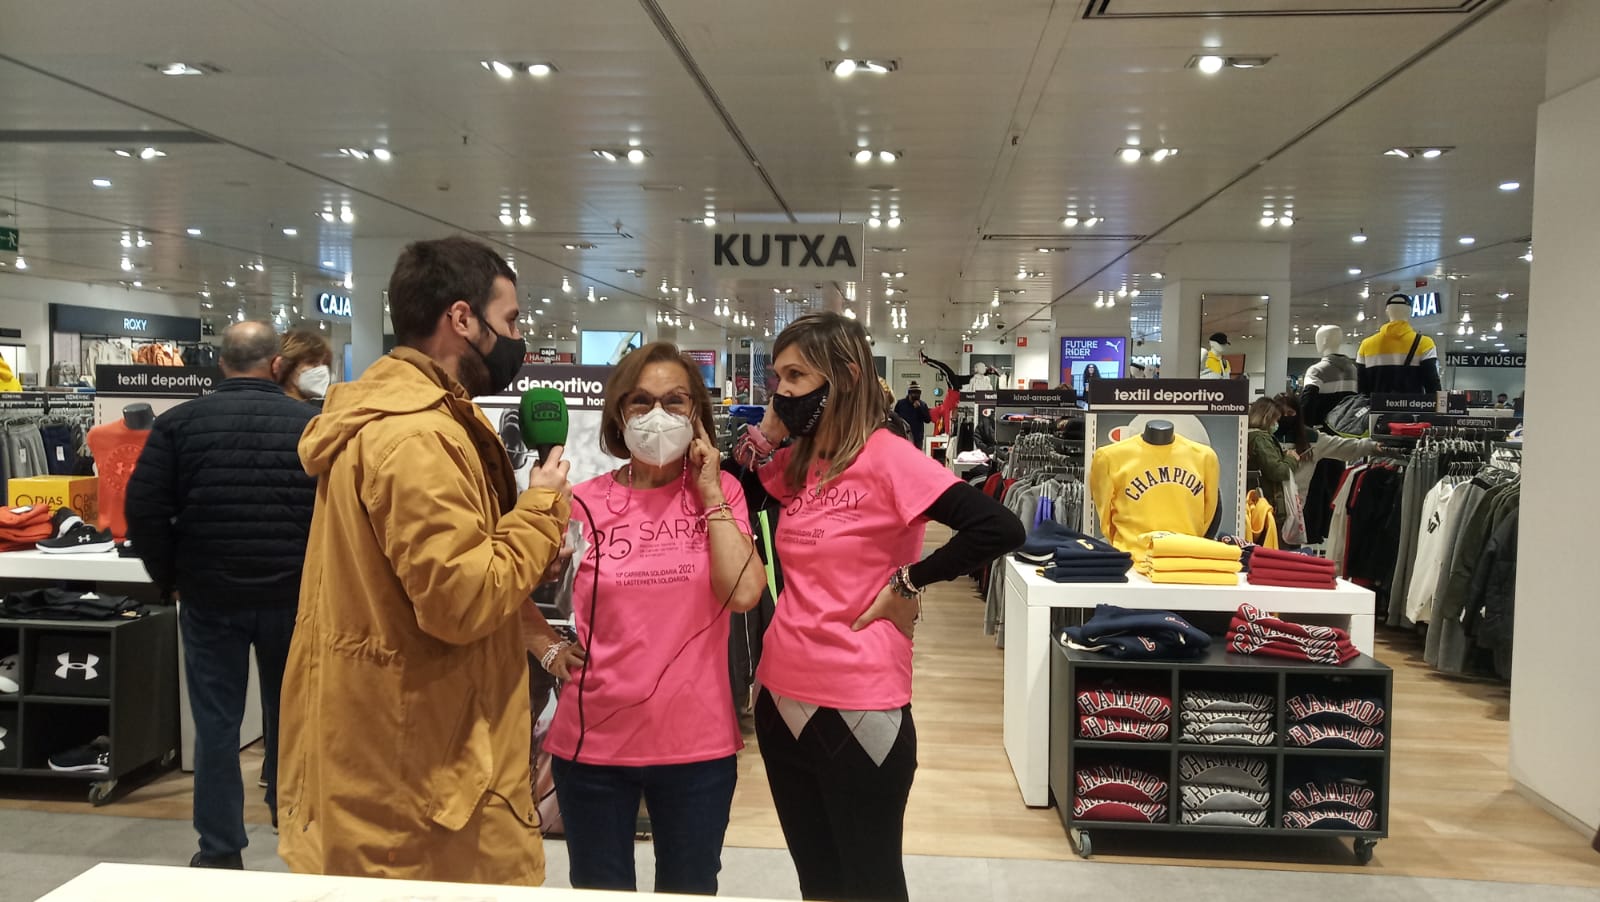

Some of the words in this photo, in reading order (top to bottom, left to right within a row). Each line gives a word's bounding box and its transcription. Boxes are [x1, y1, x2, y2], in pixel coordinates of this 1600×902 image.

[714, 232, 856, 267] KUTXA
[320, 293, 352, 317] CAJA
[1408, 292, 1437, 317] AJA
[123, 317, 147, 331] ROXY
[1065, 340, 1098, 349] FUTURE
[1065, 348, 1091, 356] RIDER
[1446, 355, 1469, 365] INE
[1472, 356, 1481, 365] Y
[1484, 353, 1526, 366] MÚSIC
[117, 373, 148, 386] textil
[151, 374, 213, 388] deportivo
[1013, 393, 1062, 403] kirol-arropak
[1114, 388, 1150, 401] textil
[1153, 388, 1225, 403] deportivo
[1386, 399, 1408, 408] textil
[1409, 399, 1438, 410] depor
[1211, 404, 1245, 412] hombre
[1125, 466, 1204, 501] CHAMPION
[807, 487, 868, 510] SARAY
[639, 519, 709, 541] SARA
[678, 564, 695, 574] 2021
[1077, 689, 1172, 722] HAMPION
[1286, 694, 1385, 726] HAMPIO
[1079, 716, 1169, 740] HAMPIO
[1287, 723, 1385, 748] HAMPIO
[1289, 782, 1375, 809] HAMPIO
